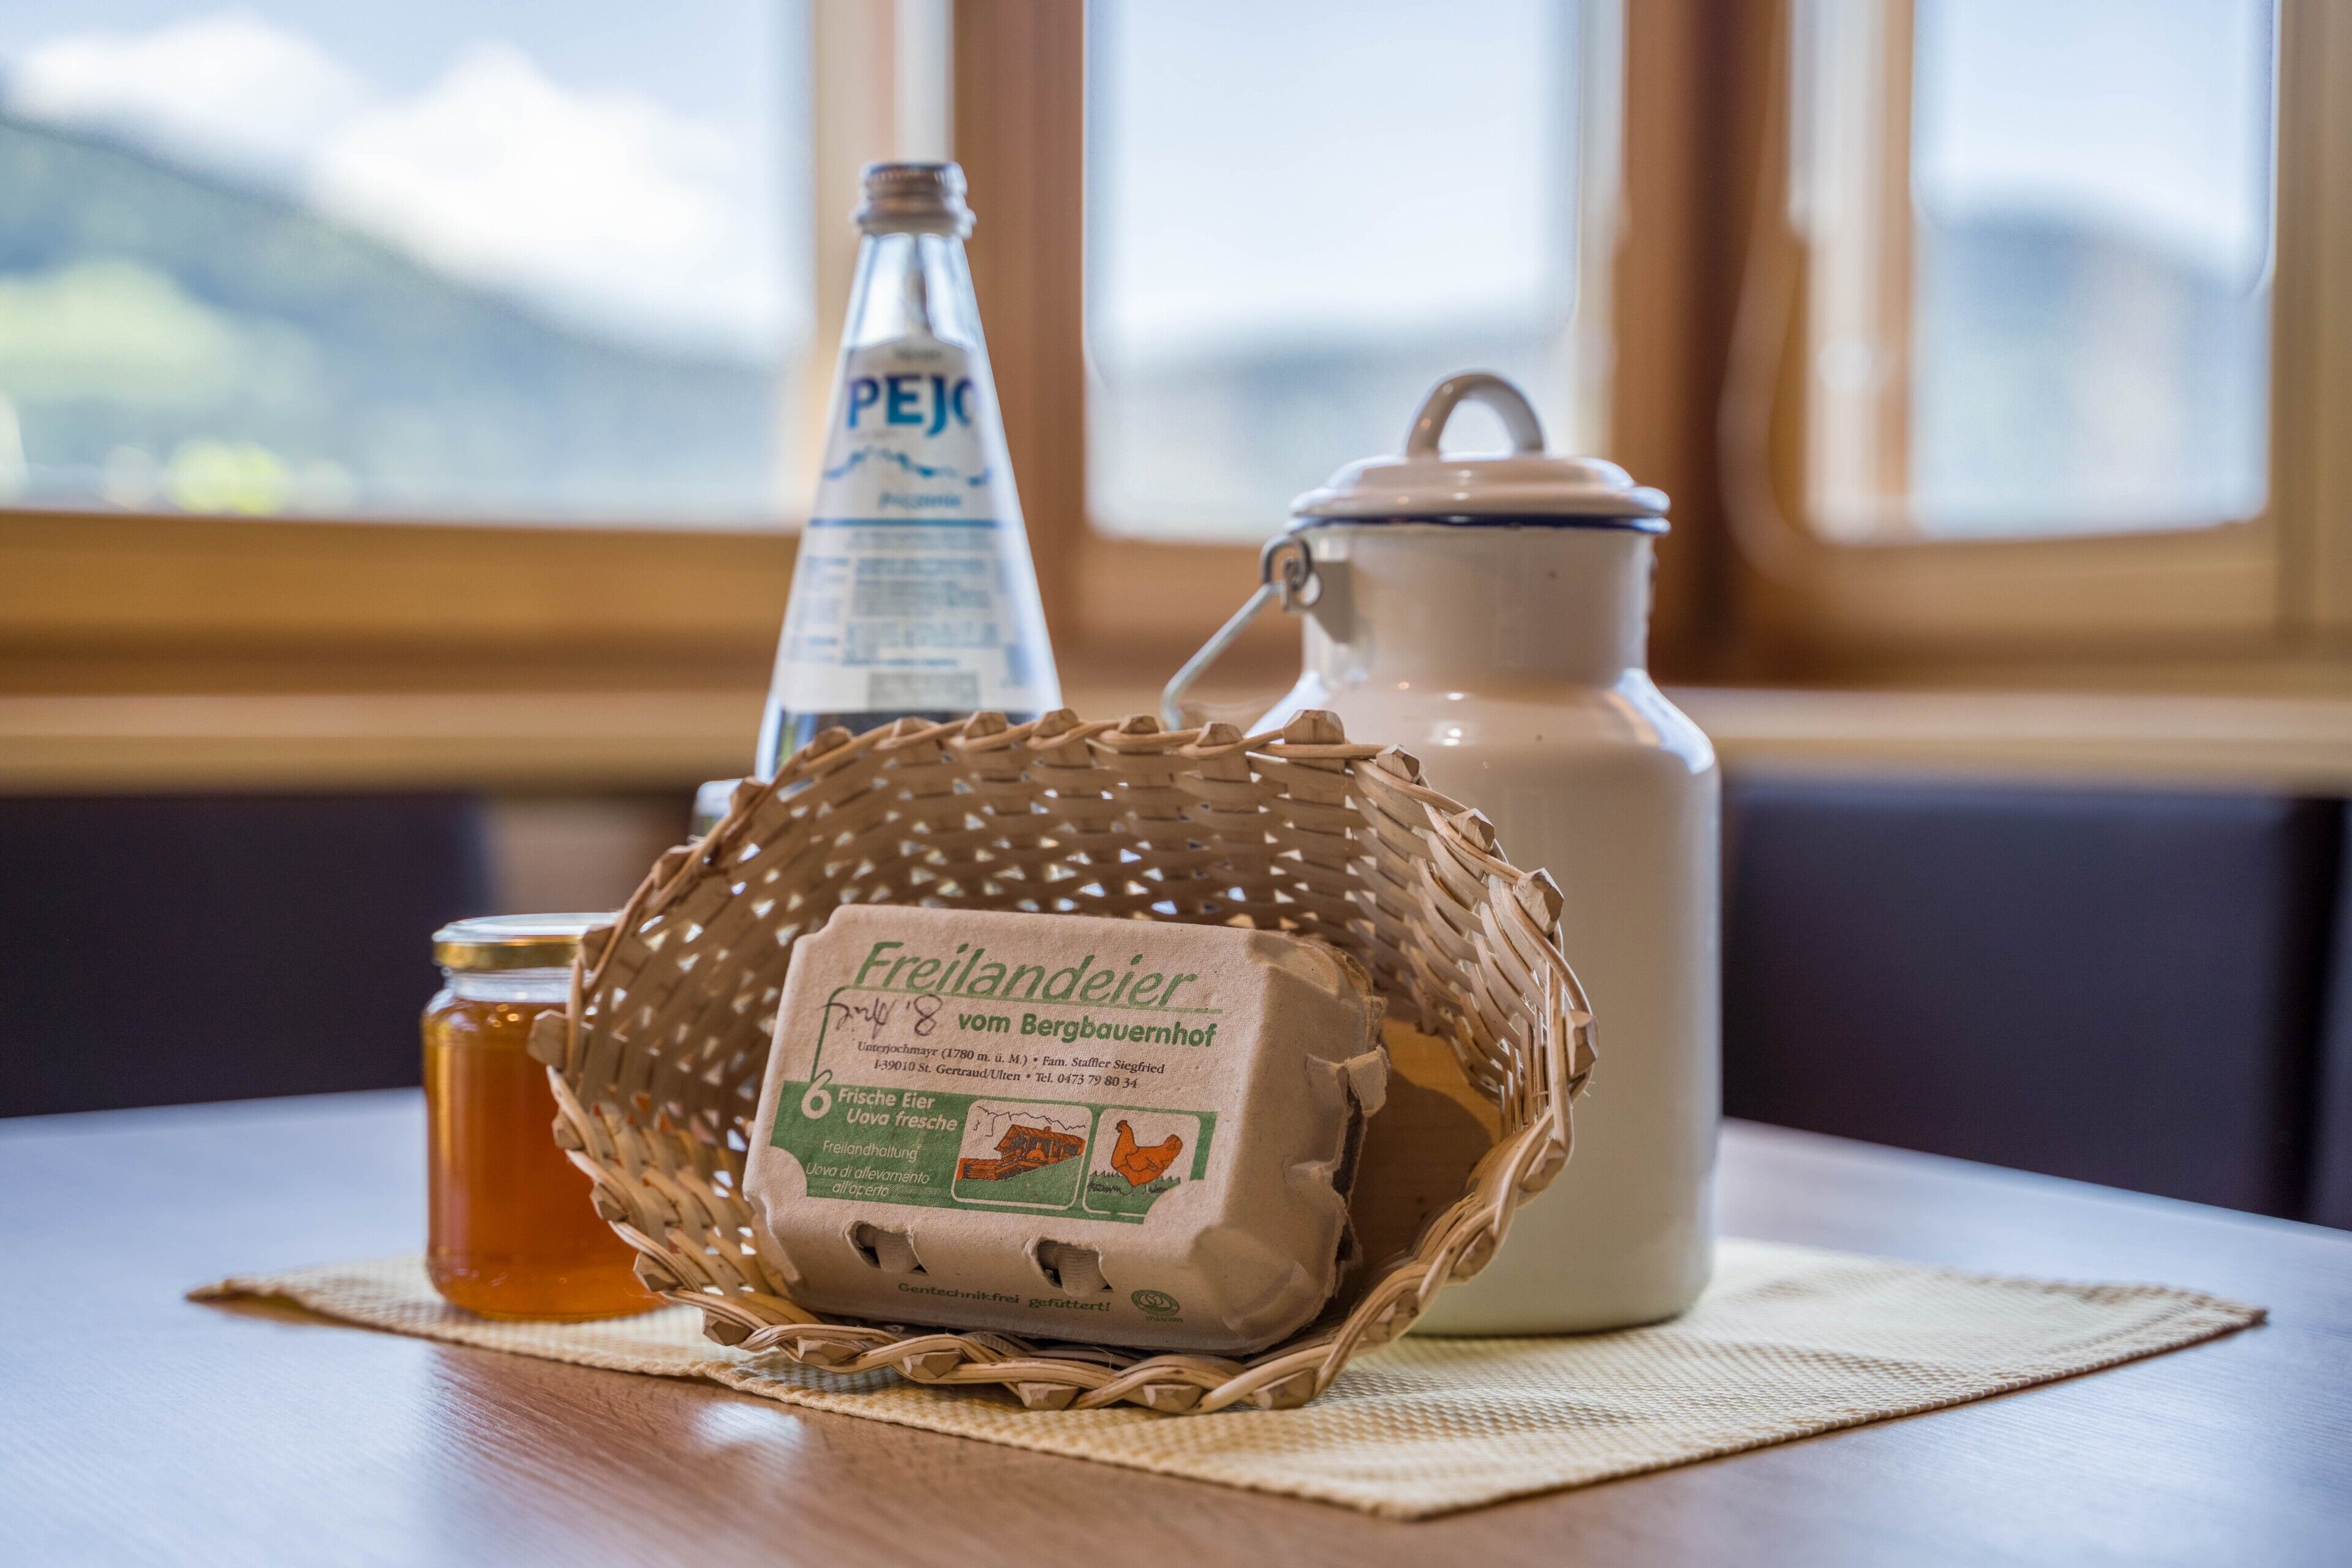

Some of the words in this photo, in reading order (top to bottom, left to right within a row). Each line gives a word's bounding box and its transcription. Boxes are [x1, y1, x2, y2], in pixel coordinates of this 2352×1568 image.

[853, 941, 1197, 1007] Freilandeier
[958, 1012, 1011, 1033] vom
[1020, 1012, 1218, 1047] Bergbauernhof
[858, 1041, 938, 1058] Unterjochmayr
[941, 1048, 974, 1060] (1780
[994, 1053, 1005, 1063] ü.
[1008, 1054, 1028, 1066] M.)
[1041, 1056, 1068, 1067] Fam.
[1071, 1057, 1111, 1068] Staffler
[1112, 1060, 1165, 1074] Siegfried
[873, 1059, 916, 1071] I-39010
[918, 1062, 932, 1073] St.
[936, 1064, 1021, 1081] Gertraud/Ulten
[1035, 1072, 1053, 1083] Tel.
[1057, 1072, 1085, 1085] 0473
[1088, 1074, 1101, 1085] 79
[1104, 1076, 1120, 1087] 80
[1122, 1077, 1138, 1088] 34
[801, 1069, 833, 1120] 6
[837, 1087, 897, 1107] Frische
[901, 1091, 936, 1110] Eier
[846, 1107, 891, 1126] Uova
[895, 1110, 959, 1131] fresche
[823, 1139, 919, 1163] Freilandhaltung
[805, 1163, 838, 1177] Uova
[840, 1164, 852, 1178] di
[854, 1166, 930, 1185] allevamento
[832, 1182, 890, 1197] all'aperto
[897, 1283, 1020, 1304] Gentechnikfrei
[1028, 1297, 1112, 1312] gefüttert!
